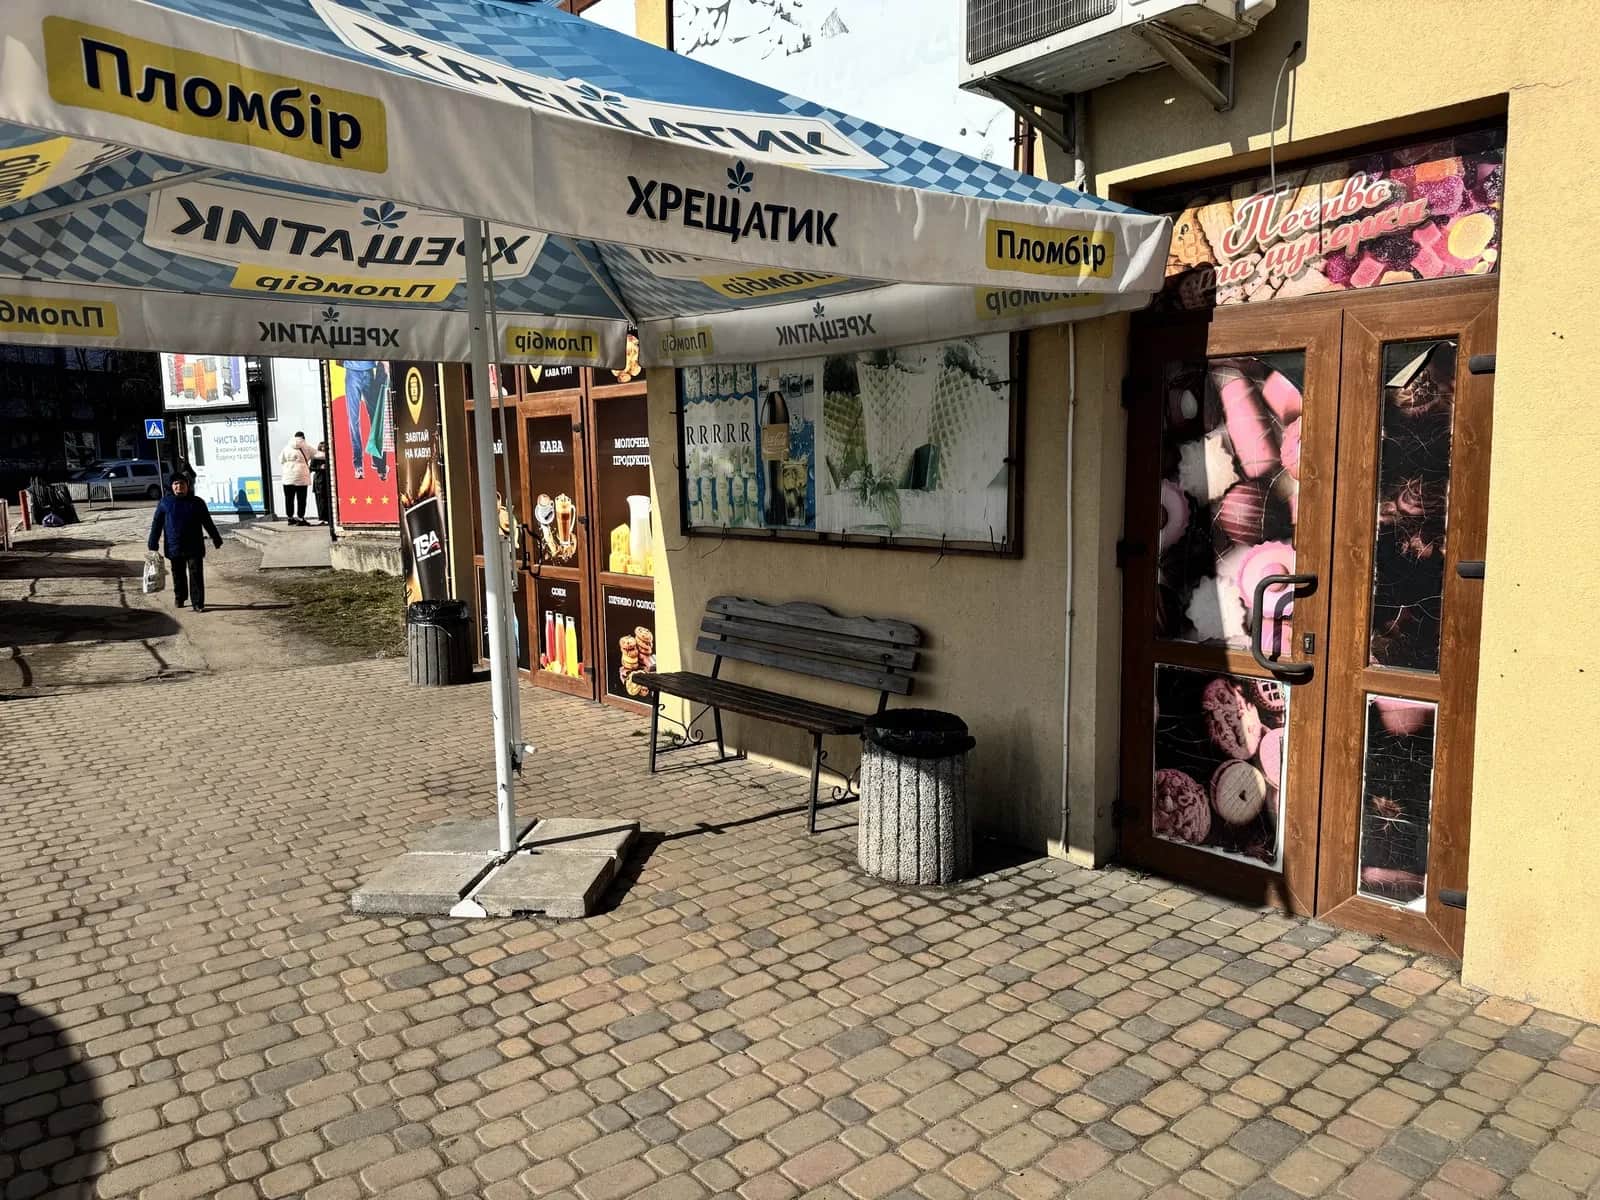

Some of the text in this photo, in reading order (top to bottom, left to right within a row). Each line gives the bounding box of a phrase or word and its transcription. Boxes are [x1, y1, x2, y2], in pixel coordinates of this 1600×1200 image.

[80, 37, 362, 159] Пломбір
[627, 174, 839, 247] ХРЕЩАТИК
[1221, 171, 1392, 257] Печиво
[1265, 198, 1428, 276] цукерки
[996, 229, 1107, 272] Пломбір
[545, 369, 559, 377] КАВА
[214, 435, 238, 445] ЧИСТА
[405, 429, 429, 442] ЗАВІТАЙ
[614, 437, 650, 449] МОЛОЧНА
[686, 425, 696, 446] R
[699, 424, 709, 445] R
[713, 423, 722, 444] R
[726, 422, 737, 443] R
[741, 421, 751, 442] R
[404, 448, 413, 458] НА
[540, 440, 564, 453] КАВА
